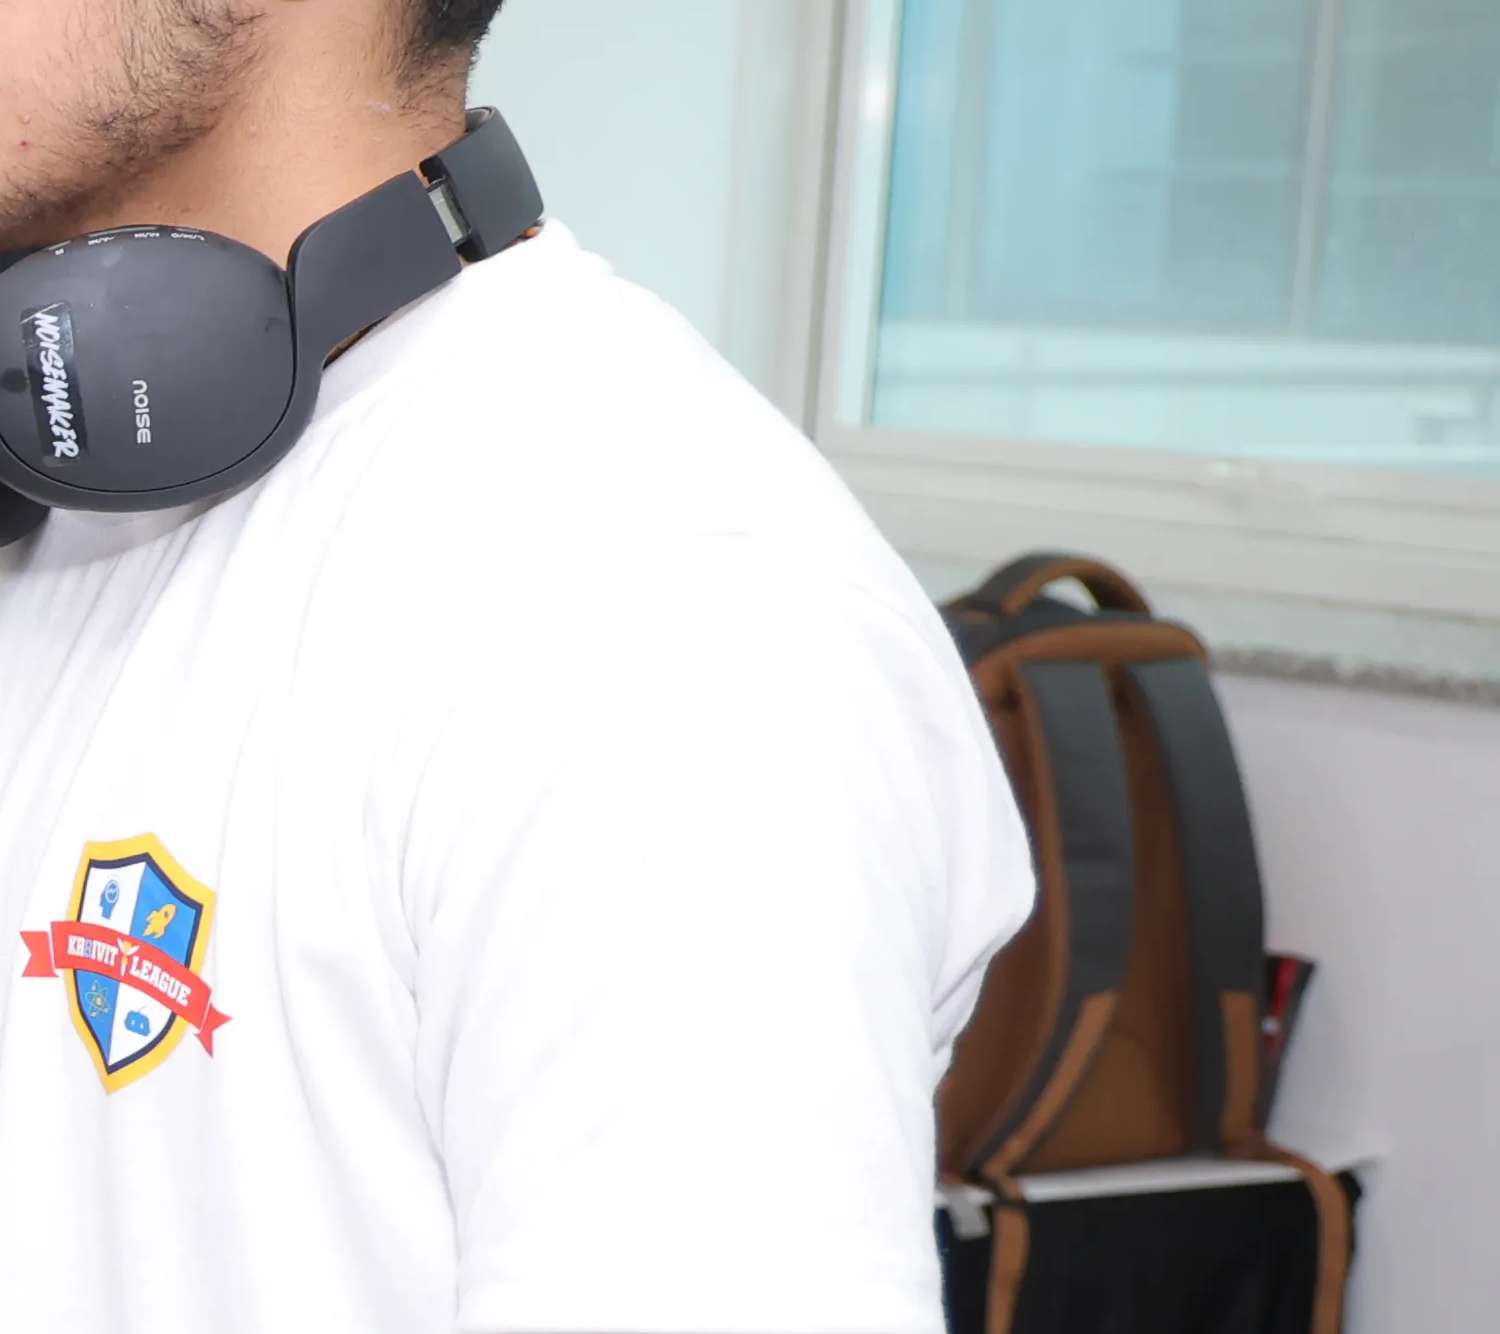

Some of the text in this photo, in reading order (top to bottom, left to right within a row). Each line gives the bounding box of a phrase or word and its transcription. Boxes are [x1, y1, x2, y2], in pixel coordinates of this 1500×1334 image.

[34, 312, 80, 458] NOISEMAKER
[132, 379, 152, 444] NOISE
[129, 954, 192, 1007] LEAGUE
